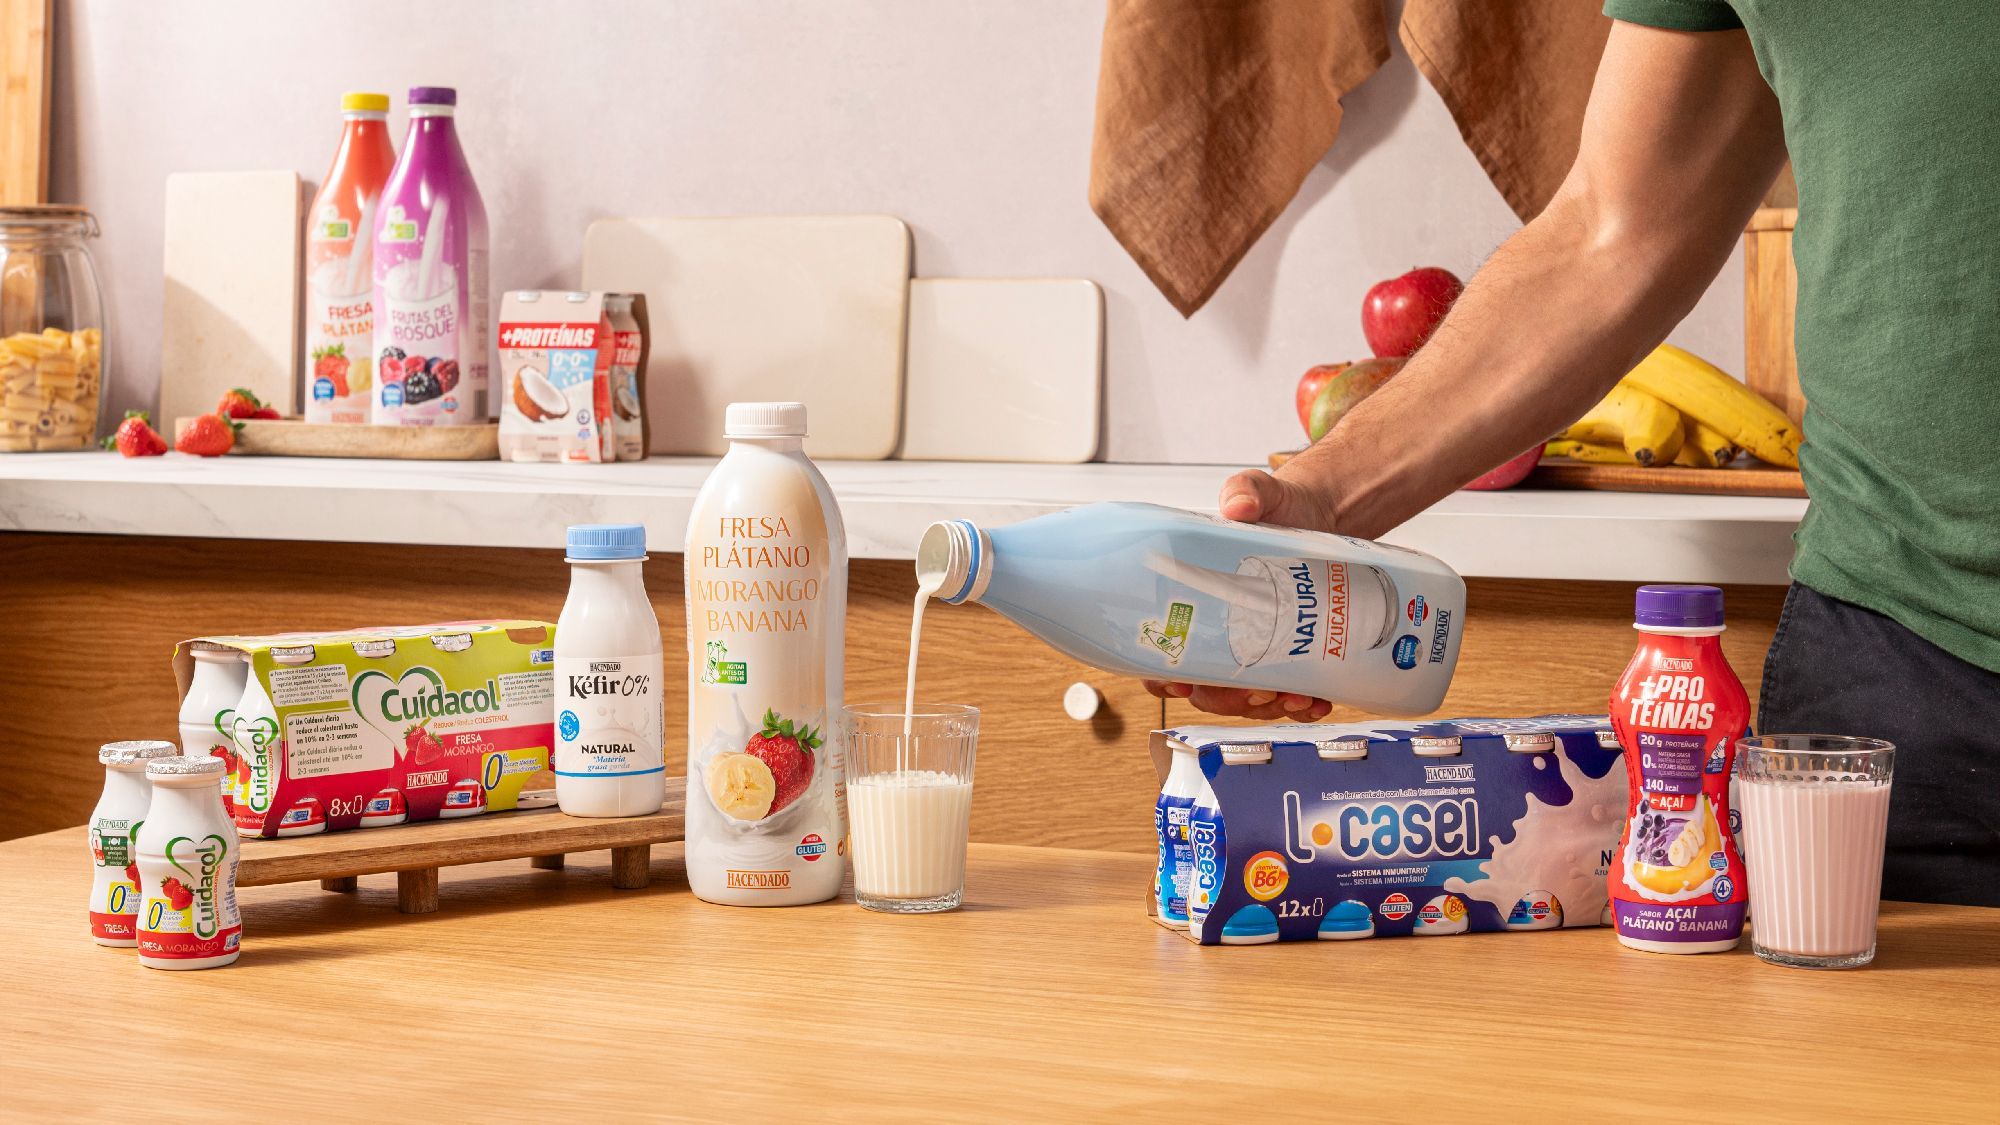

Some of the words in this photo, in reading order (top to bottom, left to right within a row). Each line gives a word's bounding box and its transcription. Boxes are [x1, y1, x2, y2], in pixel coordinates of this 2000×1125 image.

[328, 301, 373, 319] FRESA
[392, 309, 430, 324] FRUTAS
[434, 307, 454, 320] DEL
[393, 319, 455, 341] BOSQUE
[501, 323, 596, 348] +PROTEÍNAS
[719, 516, 792, 539] FRESA
[703, 540, 810, 569] PLÁTANO
[696, 578, 818, 602] MORANGO
[1288, 562, 1318, 656] NATURAL
[1327, 563, 1346, 658] AZUCARADO
[1414, 596, 1424, 626] GLUTEN
[705, 608, 809, 633] BANANA
[1431, 610, 1449, 663] HACENDADO
[590, 663, 621, 672] HACENDADO
[568, 675, 621, 699] Kéfir
[1638, 674, 1705, 701] +PRO
[380, 680, 500, 722] Cuidacol
[296, 718, 304, 726] Un
[304, 715, 324, 725] Cuidacol
[474, 714, 509, 725] COLESTEROL
[1629, 698, 1715, 730] TEÍNAS
[314, 725, 319, 733] el
[320, 723, 344, 733] colesterol
[344, 722, 359, 730] hasta
[304, 735, 317, 744] 10%
[325, 733, 335, 741] 2-3
[336, 732, 358, 740] semanas
[455, 733, 482, 746] FRESA
[1640, 734, 1656, 746] 20
[1656, 738, 1663, 748] g
[1665, 740, 1699, 749] PROTEÍNAS
[443, 742, 495, 758] MORANGO
[581, 743, 636, 754] NATURAL
[247, 726, 269, 812] Cuidacol
[587, 764, 608, 772] grasa
[1642, 753, 1657, 769] 0%
[297, 767, 307, 776] 2-3
[407, 772, 449, 787] HACENDADO
[1426, 767, 1474, 780] HACENDADO
[1645, 778, 1664, 791] 140
[1665, 783, 1679, 793] kcal
[1322, 791, 1345, 801] Leche
[1344, 789, 1385, 800] fermentada
[1386, 790, 1399, 799] con
[1659, 794, 1685, 812] AÇAÍ
[797, 844, 826, 855] GLUTEN
[1255, 863, 1279, 871] vitamina
[1351, 868, 1381, 877] SISTEMA
[727, 873, 790, 887] HACENDADO
[1353, 877, 1383, 886] SISTEMA
[194, 844, 217, 938] Cuidacol
[1278, 899, 1311, 918] 12x
[1382, 904, 1411, 912] GLUTEN
[1639, 909, 1662, 919] SABOR
[1665, 906, 1698, 923] AÇAÍ
[104, 923, 130, 934] FRESA
[1622, 915, 1675, 932] PLÁTANO
[1678, 919, 1729, 932] BANANA
[142, 941, 164, 952] FRESA
[166, 942, 219, 952] MORANGO
